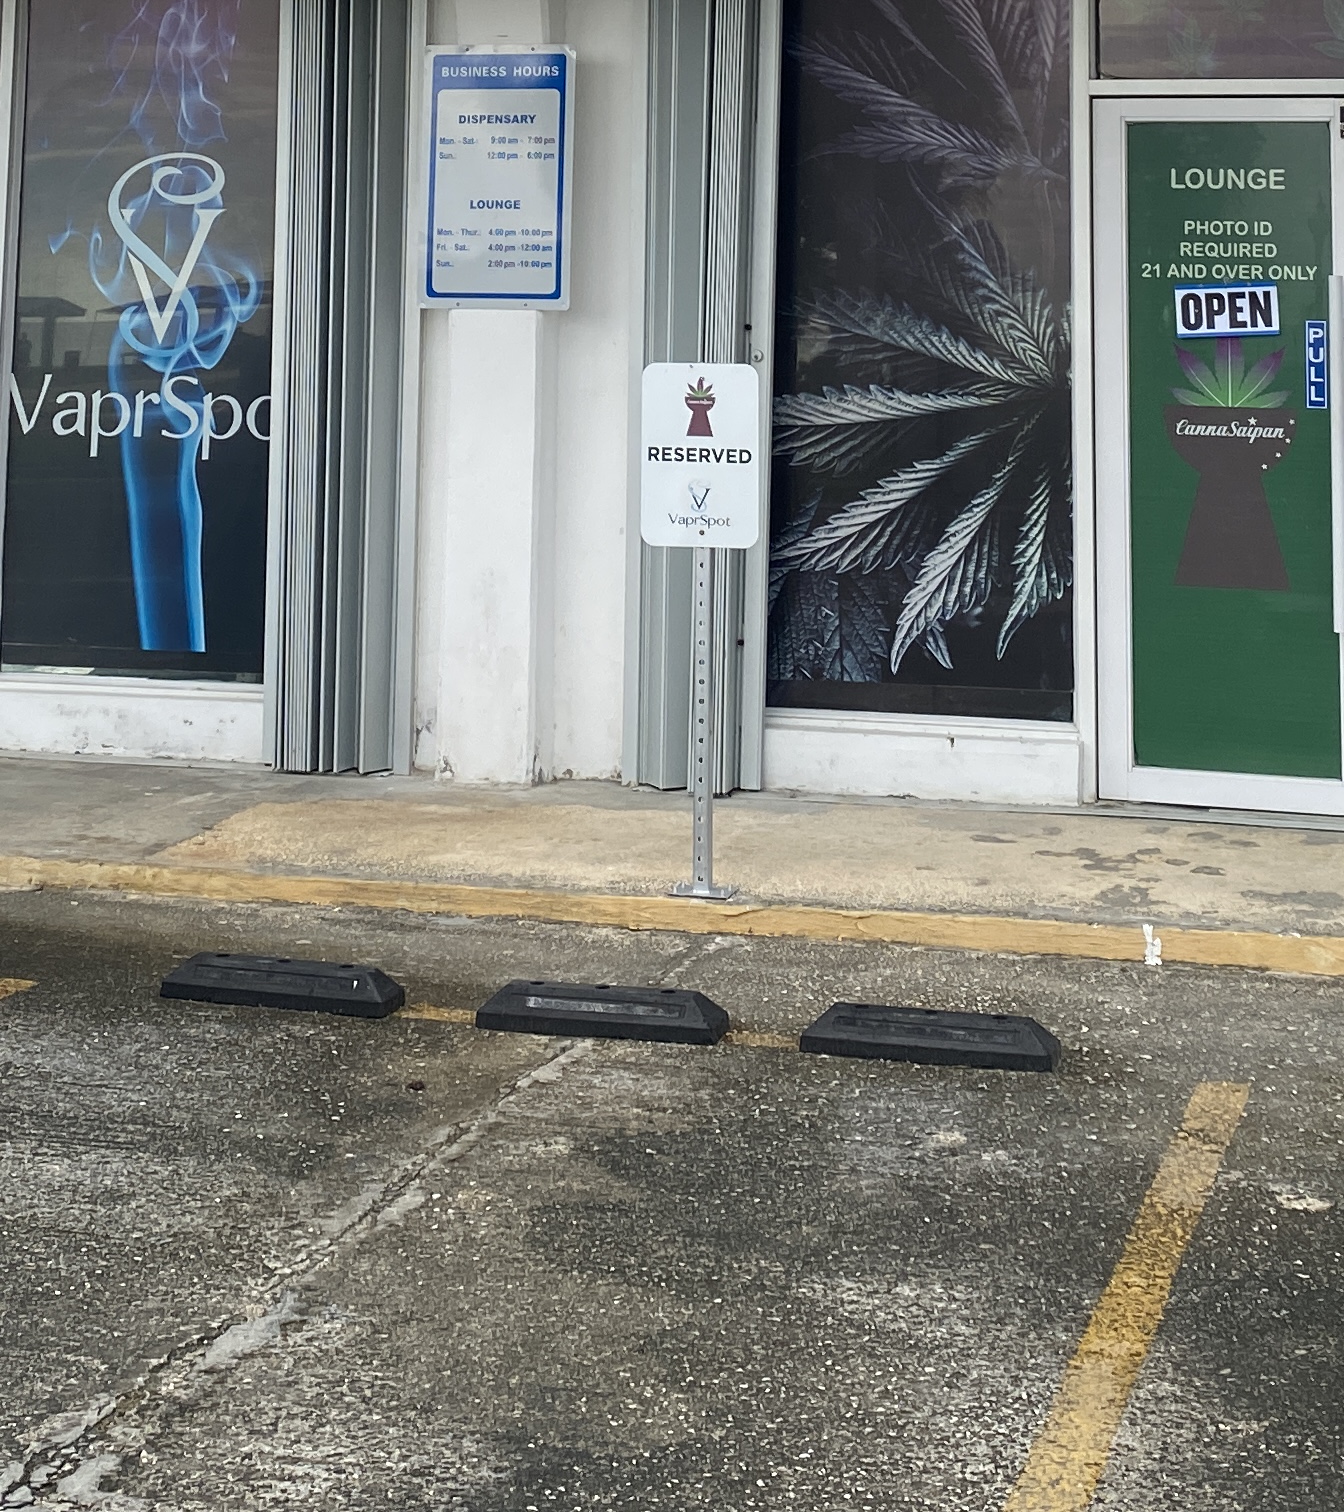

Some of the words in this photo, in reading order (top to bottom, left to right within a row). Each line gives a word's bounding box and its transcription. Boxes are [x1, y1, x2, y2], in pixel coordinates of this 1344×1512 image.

[441, 66, 507, 78] BUSINESS
[513, 65, 560, 77] HOURS
[458, 114, 537, 124] DISPENSARY
[1170, 168, 1286, 190] LOUNGE
[469, 199, 521, 210] LOUNGE
[1183, 220, 1249, 236] PHOTO
[1253, 220, 1273, 236] ID
[1179, 242, 1277, 259] REQUIRED
[1141, 264, 1161, 278] 21
[1166, 264, 1207, 279] AND
[1211, 265, 1264, 280] OVER
[1268, 265, 1318, 282] ONLY
[1180, 290, 1273, 331] OPEN
[1308, 327, 1324, 403] PULL
[10, 372, 272, 460] VaprSpo
[1175, 418, 1286, 444] CannaSaipan
[648, 446, 753, 464] RESERVED
[668, 512, 731, 529] VaprSpot
